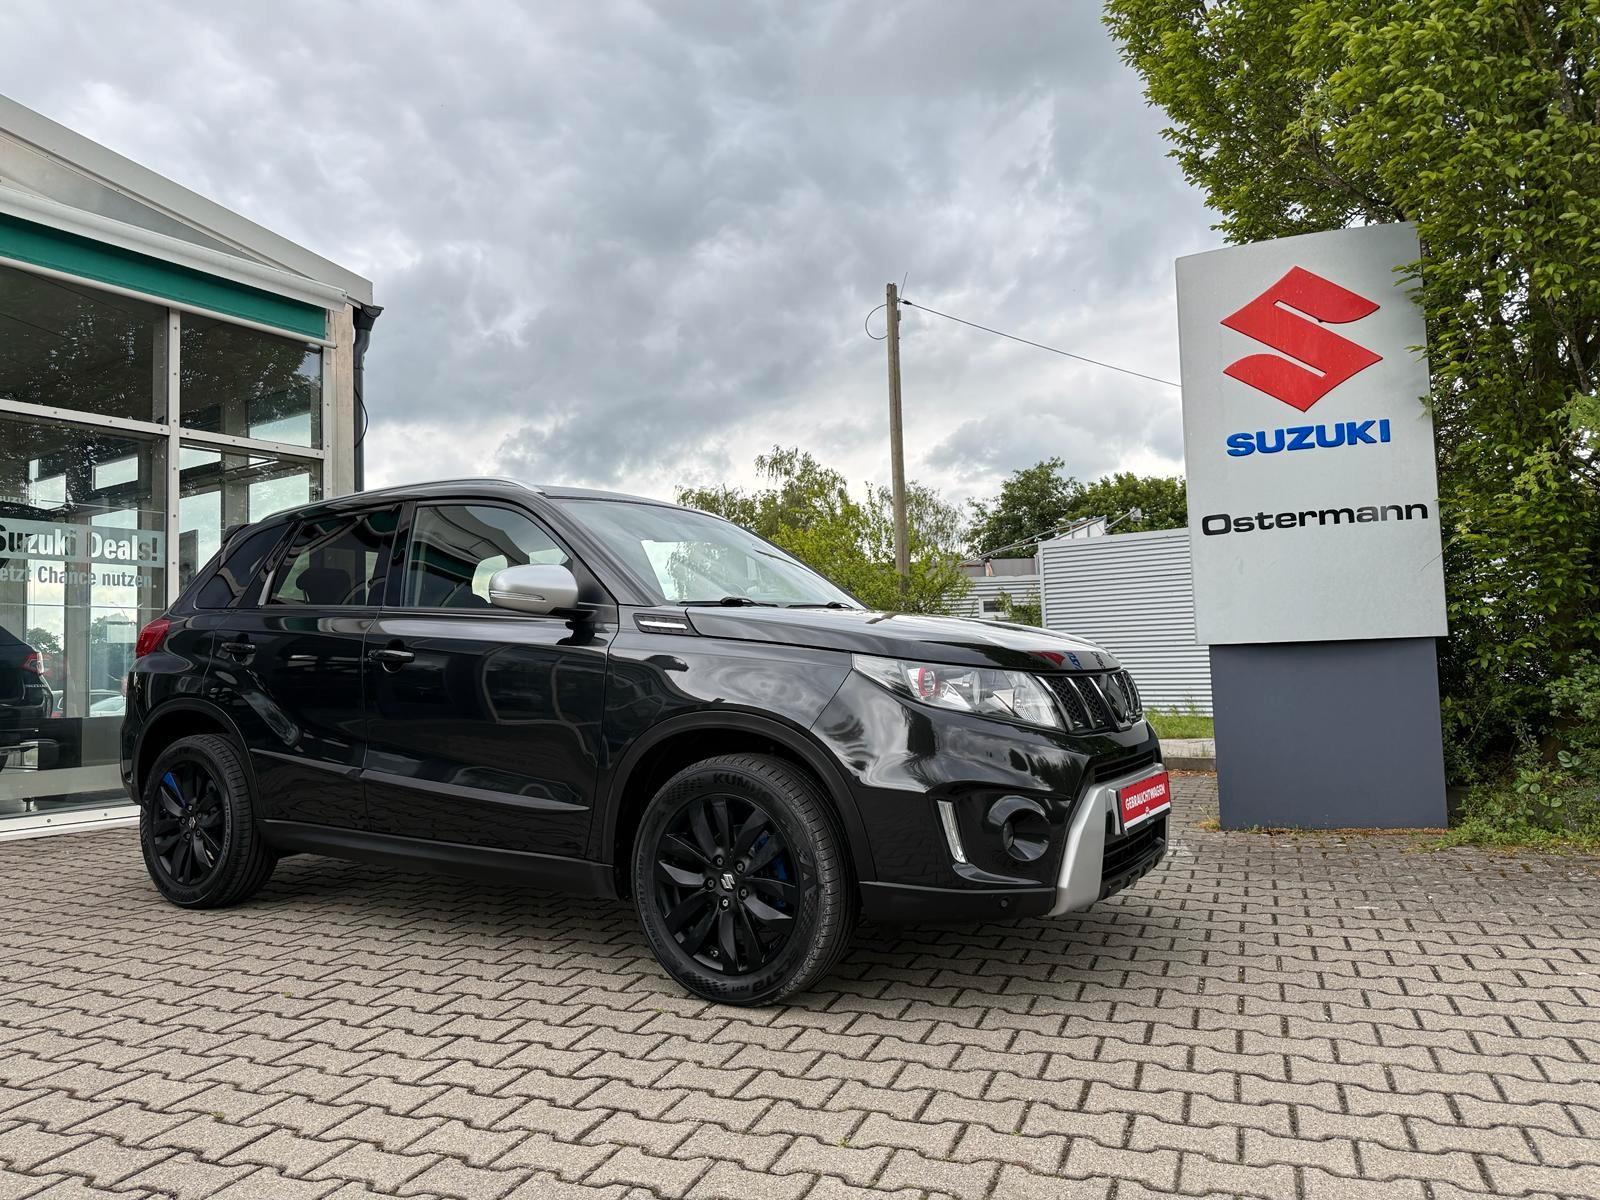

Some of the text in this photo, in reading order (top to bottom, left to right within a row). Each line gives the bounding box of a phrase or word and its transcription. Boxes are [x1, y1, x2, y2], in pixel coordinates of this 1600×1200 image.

[1226, 419, 1391, 457] SUZUKI
[1201, 503, 1428, 536] Ostermann
[0, 524, 158, 562] Suzuki Deals!
[0, 565, 157, 589] etzt Chance nutzen.
[1125, 782, 1166, 811] GEBRAUCHTWAGEN
